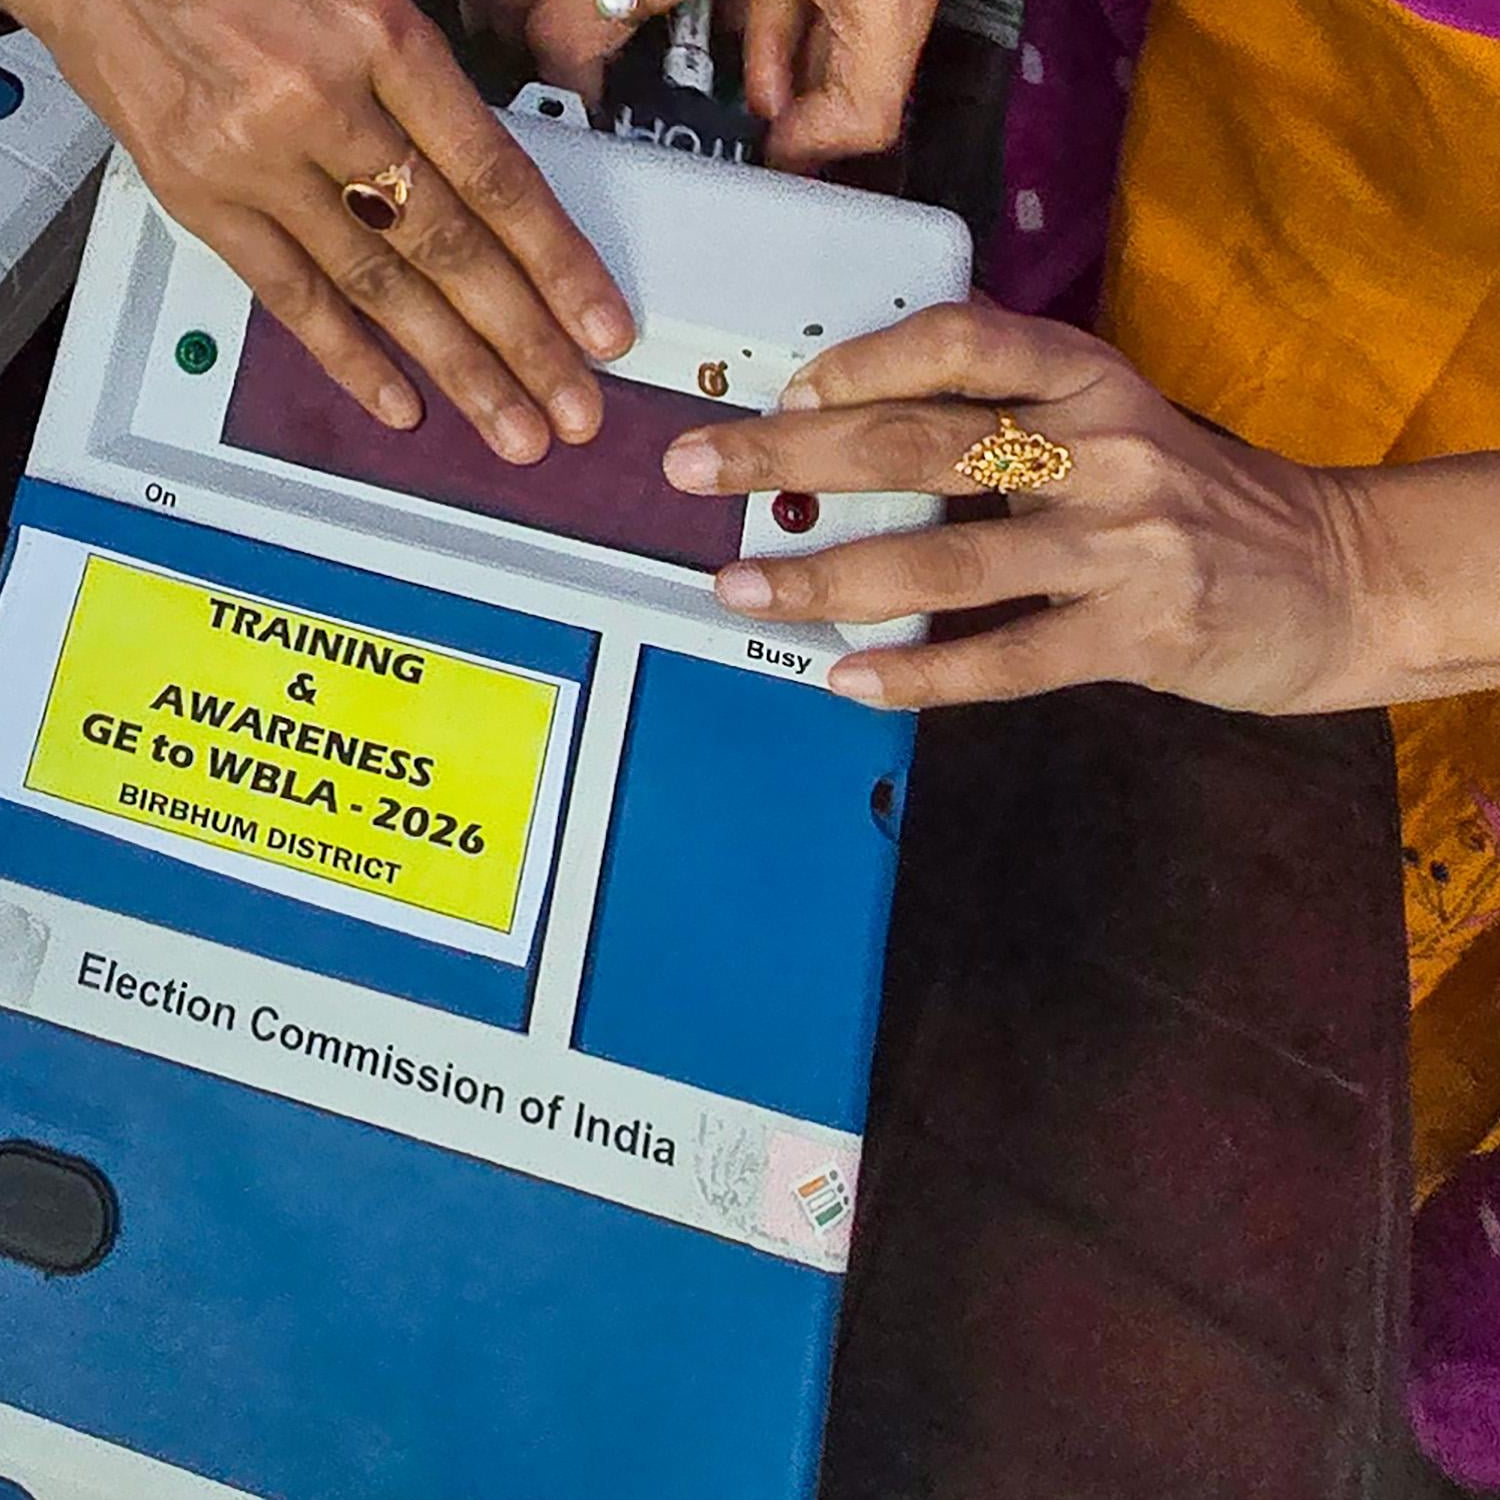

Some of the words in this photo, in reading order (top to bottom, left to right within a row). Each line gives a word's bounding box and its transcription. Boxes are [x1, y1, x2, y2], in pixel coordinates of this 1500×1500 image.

[146, 483, 175, 507] On
[210, 598, 424, 684] TRAINING
[747, 640, 811, 674] Busy
[150, 683, 433, 787] AWARENESS
[288, 673, 316, 705] &
[83, 714, 142, 754] GE
[152, 735, 193, 768] to
[210, 747, 337, 813] WBLA
[351, 804, 362, 812] -
[373, 797, 484, 854] 2026
[119, 782, 258, 845] BIRBHUM
[267, 828, 401, 883] DISTRICT
[78, 952, 235, 1030] Election
[251, 1006, 504, 1113] Commission
[521, 1095, 564, 1129] of
[575, 1103, 674, 1166] India
